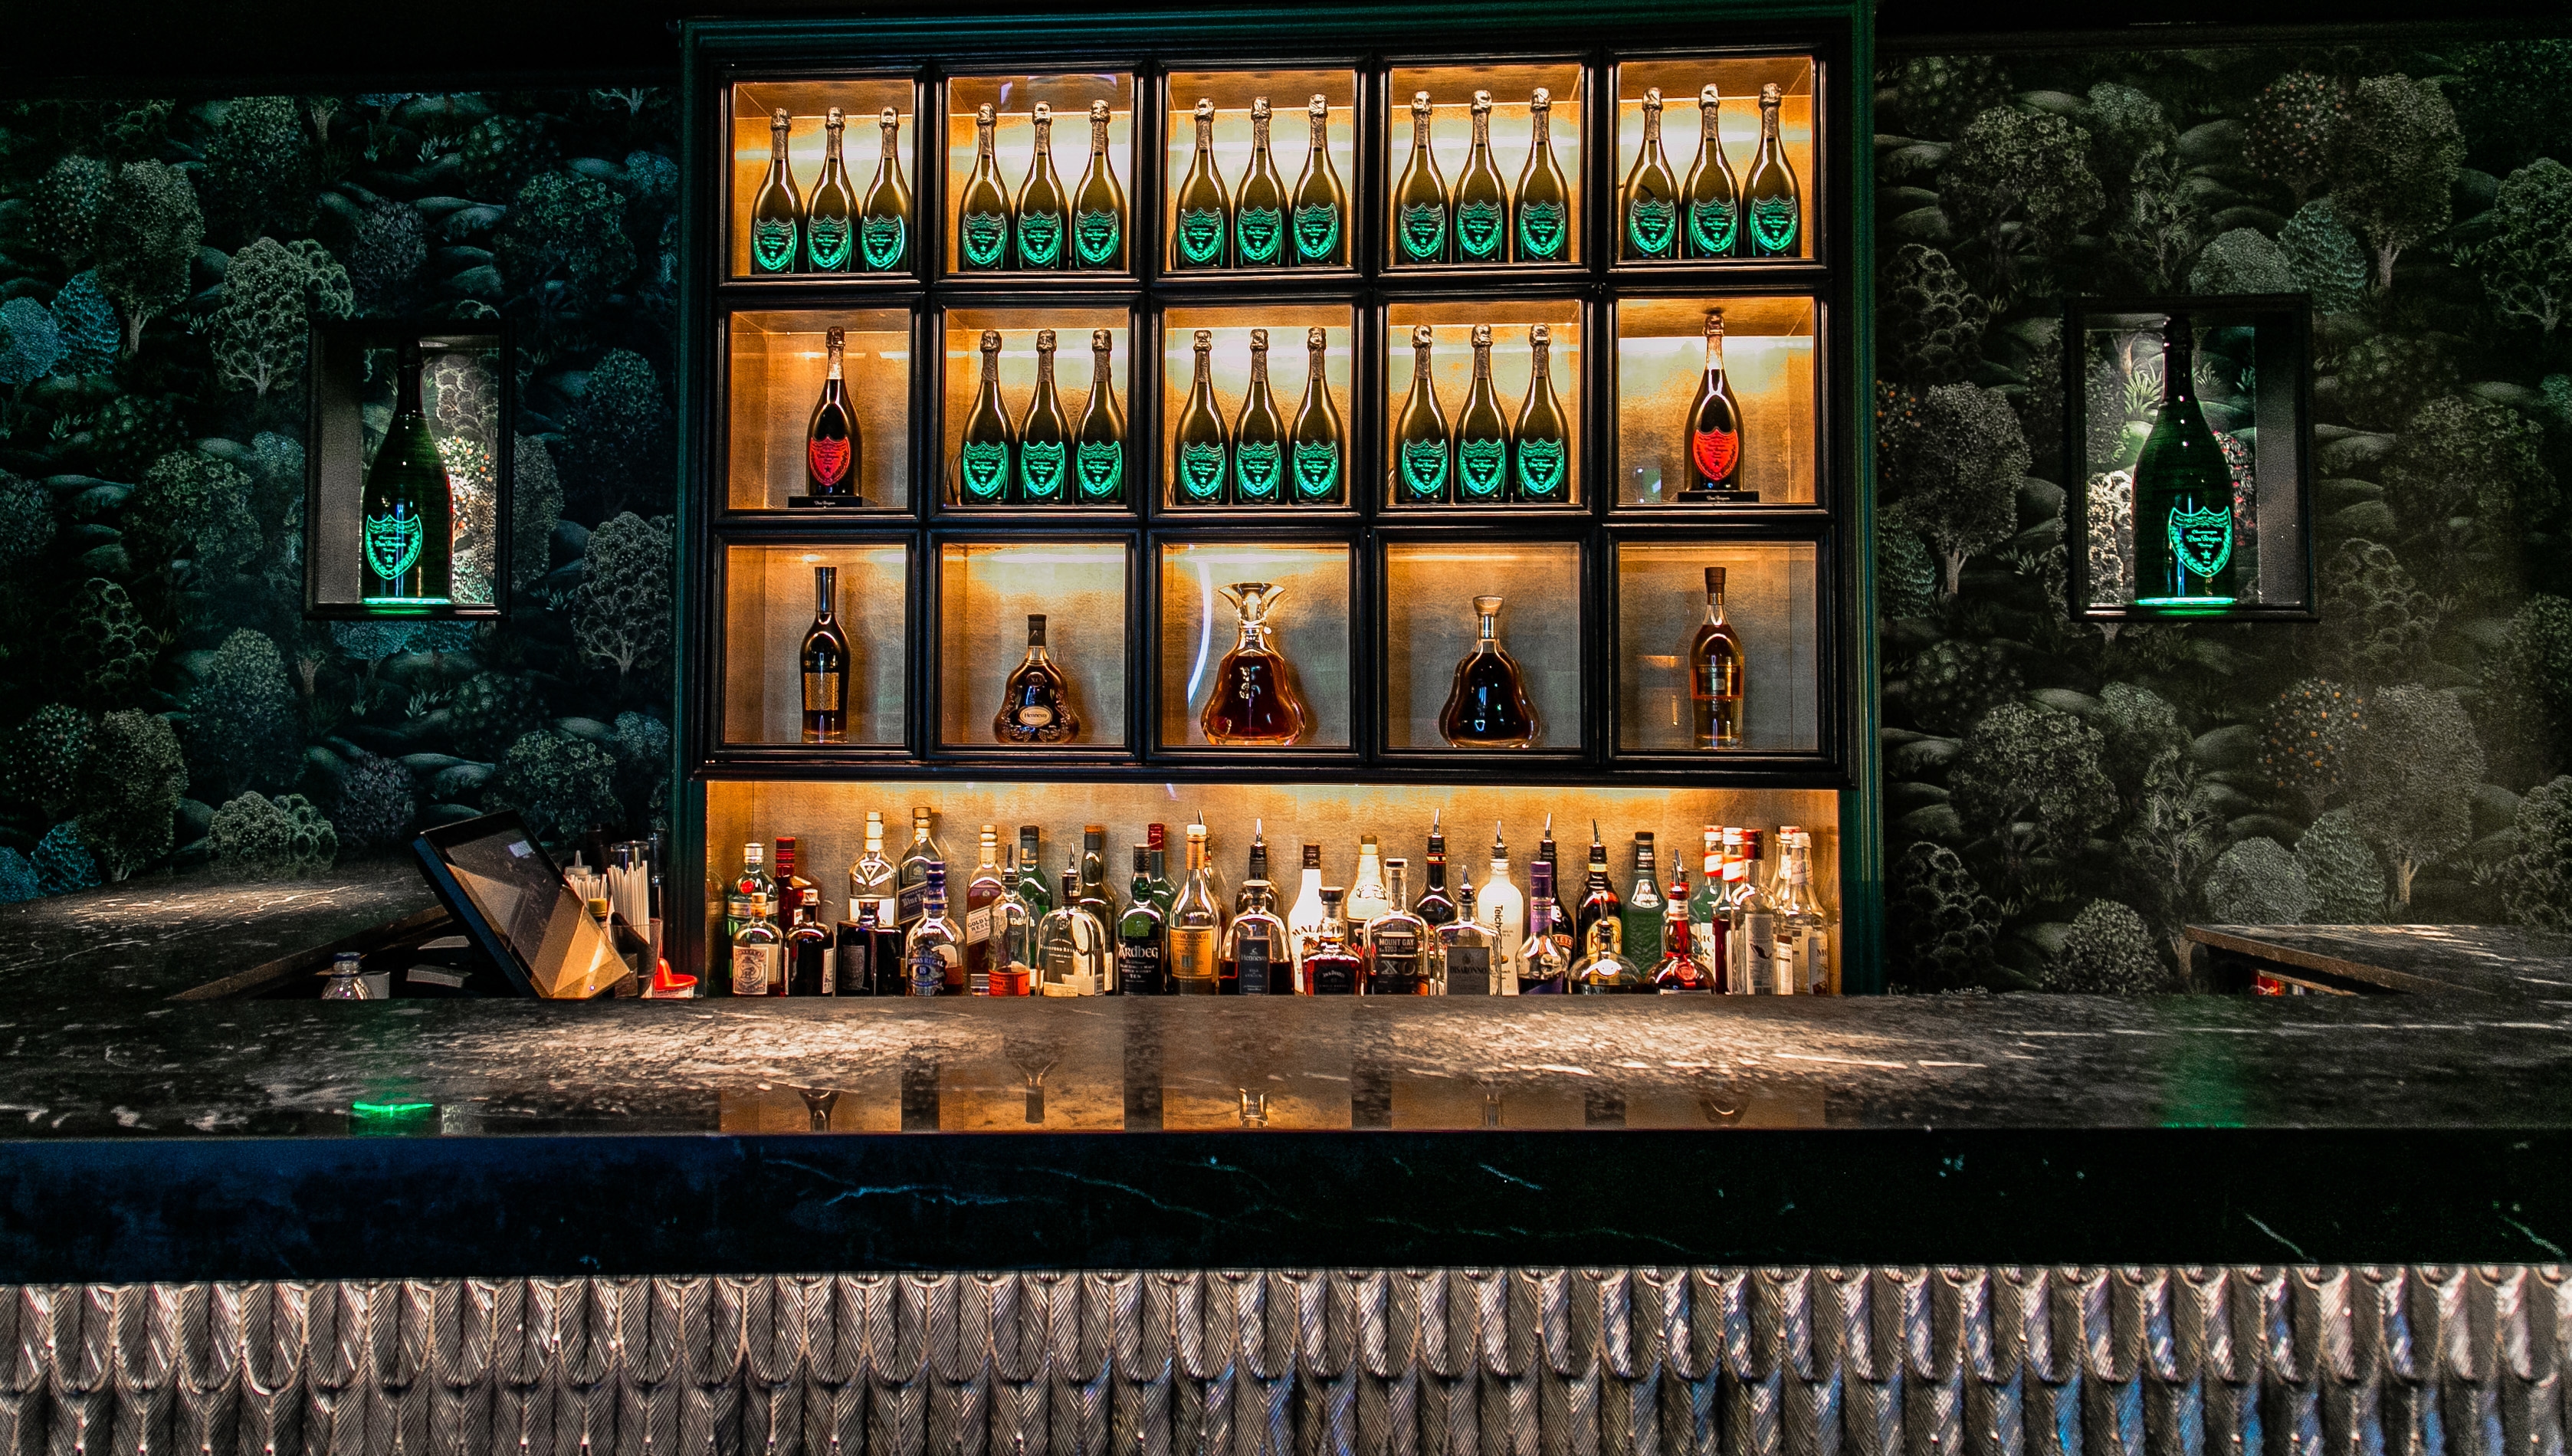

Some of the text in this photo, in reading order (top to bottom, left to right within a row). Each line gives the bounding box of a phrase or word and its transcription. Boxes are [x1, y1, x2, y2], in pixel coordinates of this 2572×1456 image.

[1024, 712, 1047, 721] Hennessy
[967, 919, 984, 928] GOLD
[1402, 938, 1414, 946] GAY
[1450, 966, 1487, 975] DISARONNO
